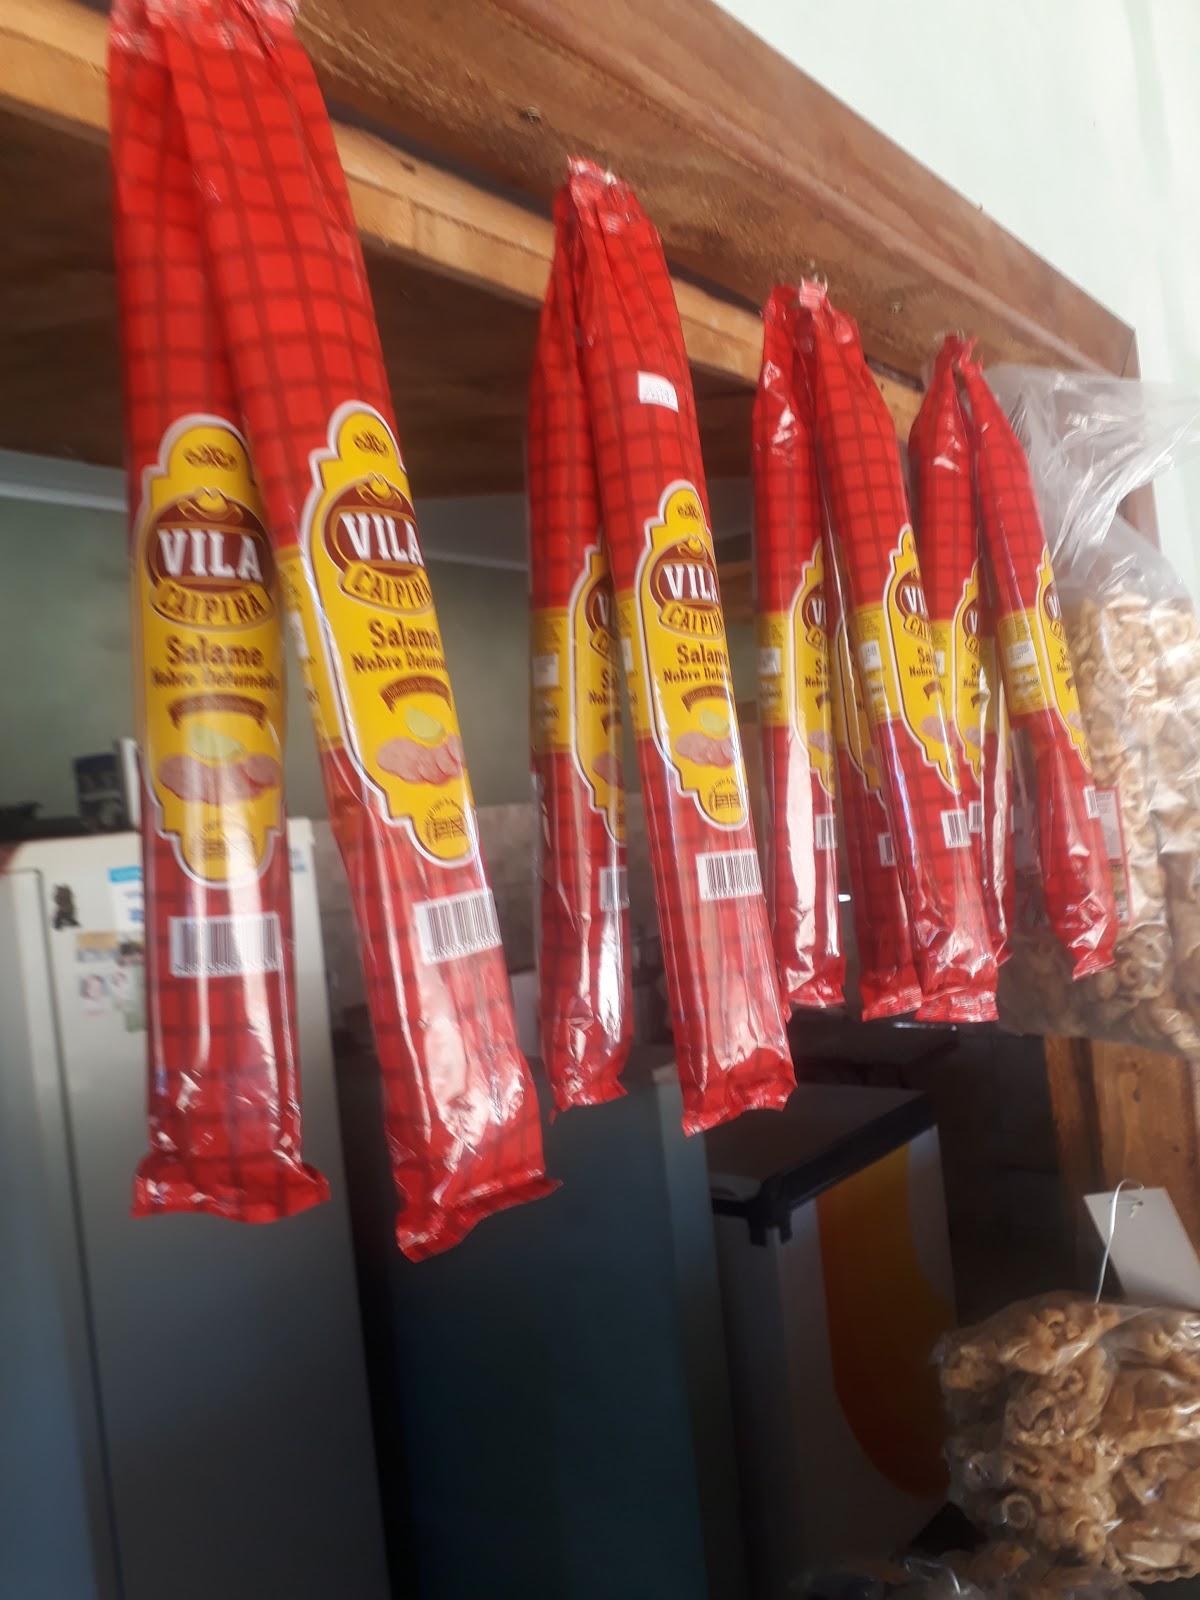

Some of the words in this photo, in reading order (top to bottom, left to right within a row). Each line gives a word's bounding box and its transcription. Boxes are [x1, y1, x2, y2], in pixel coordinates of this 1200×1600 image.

[157, 528, 263, 581] VILA
[340, 511, 425, 567] VILA
[166, 635, 264, 666] Salame
[352, 653, 401, 672] Nobre
[663, 669, 702, 683] Nobre
